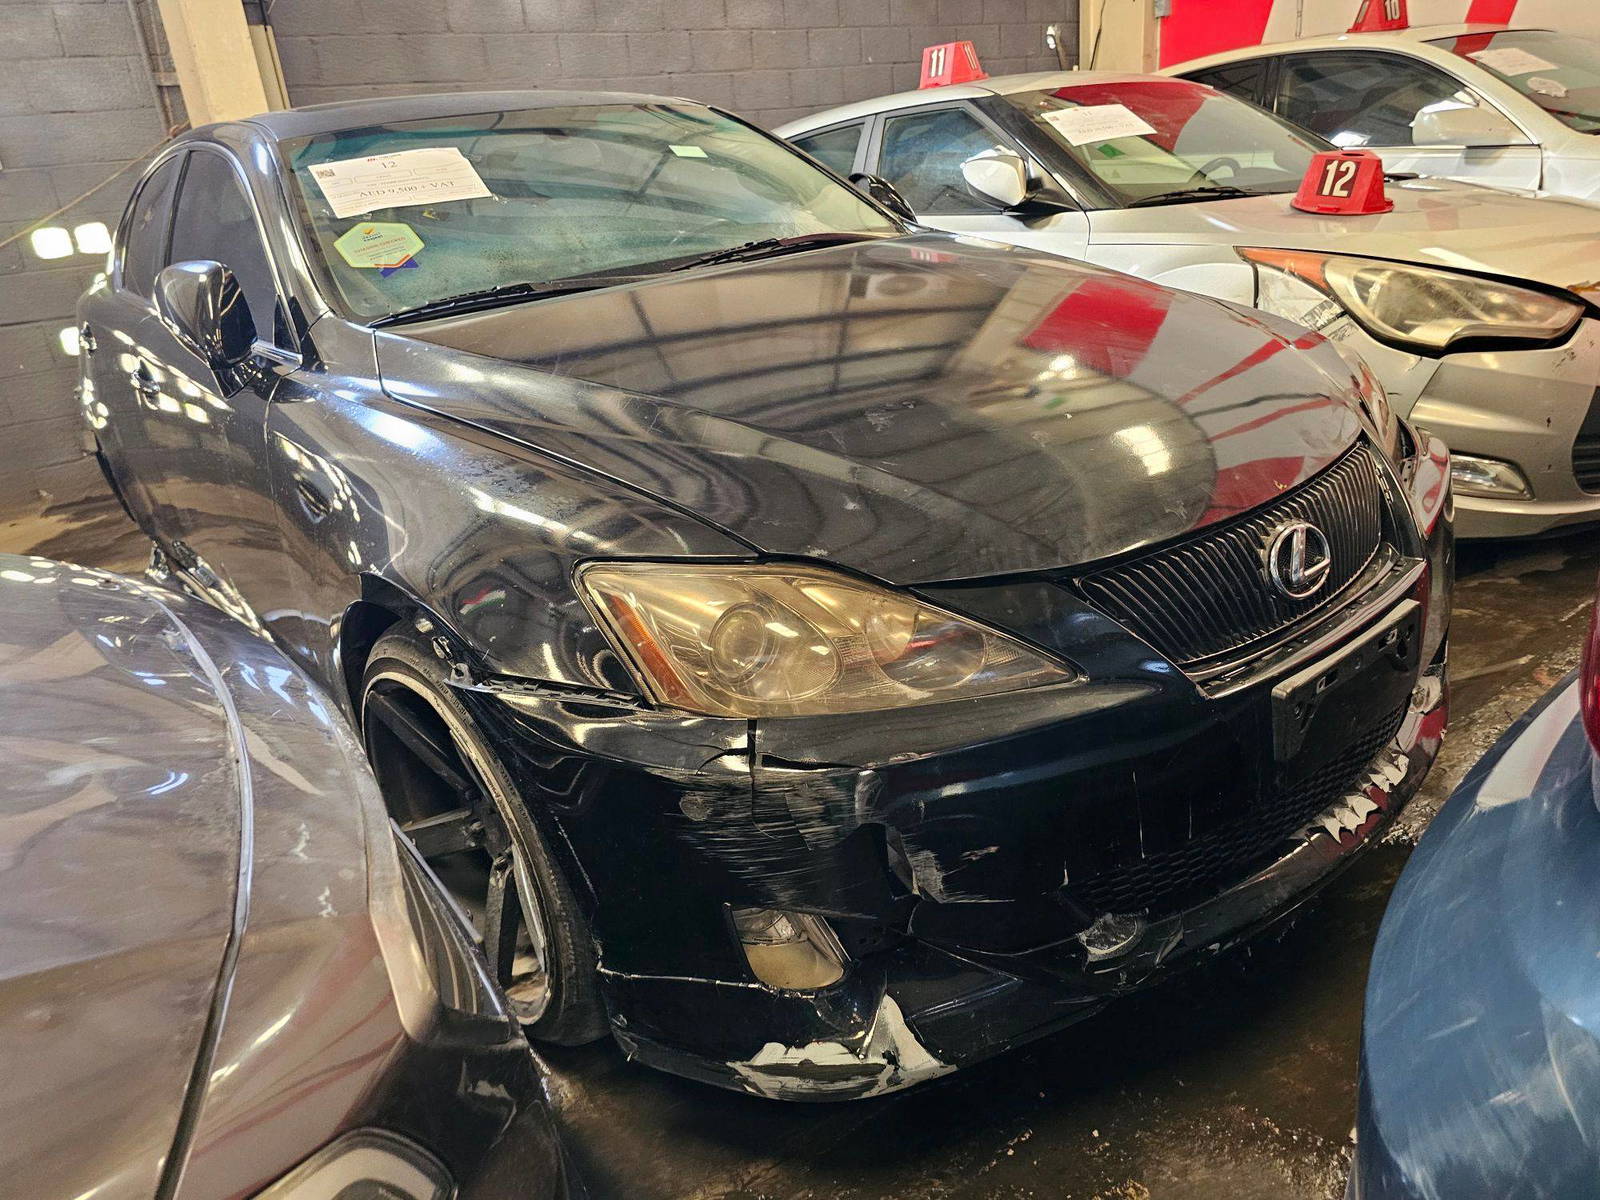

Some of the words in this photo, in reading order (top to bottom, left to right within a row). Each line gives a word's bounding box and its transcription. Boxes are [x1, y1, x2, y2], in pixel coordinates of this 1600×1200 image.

[1385, 0, 1400, 20] 10
[931, 47, 946, 78] 11
[382, 160, 399, 169] 12
[430, 181, 455, 189] VAT
[1321, 159, 1357, 198] 12
